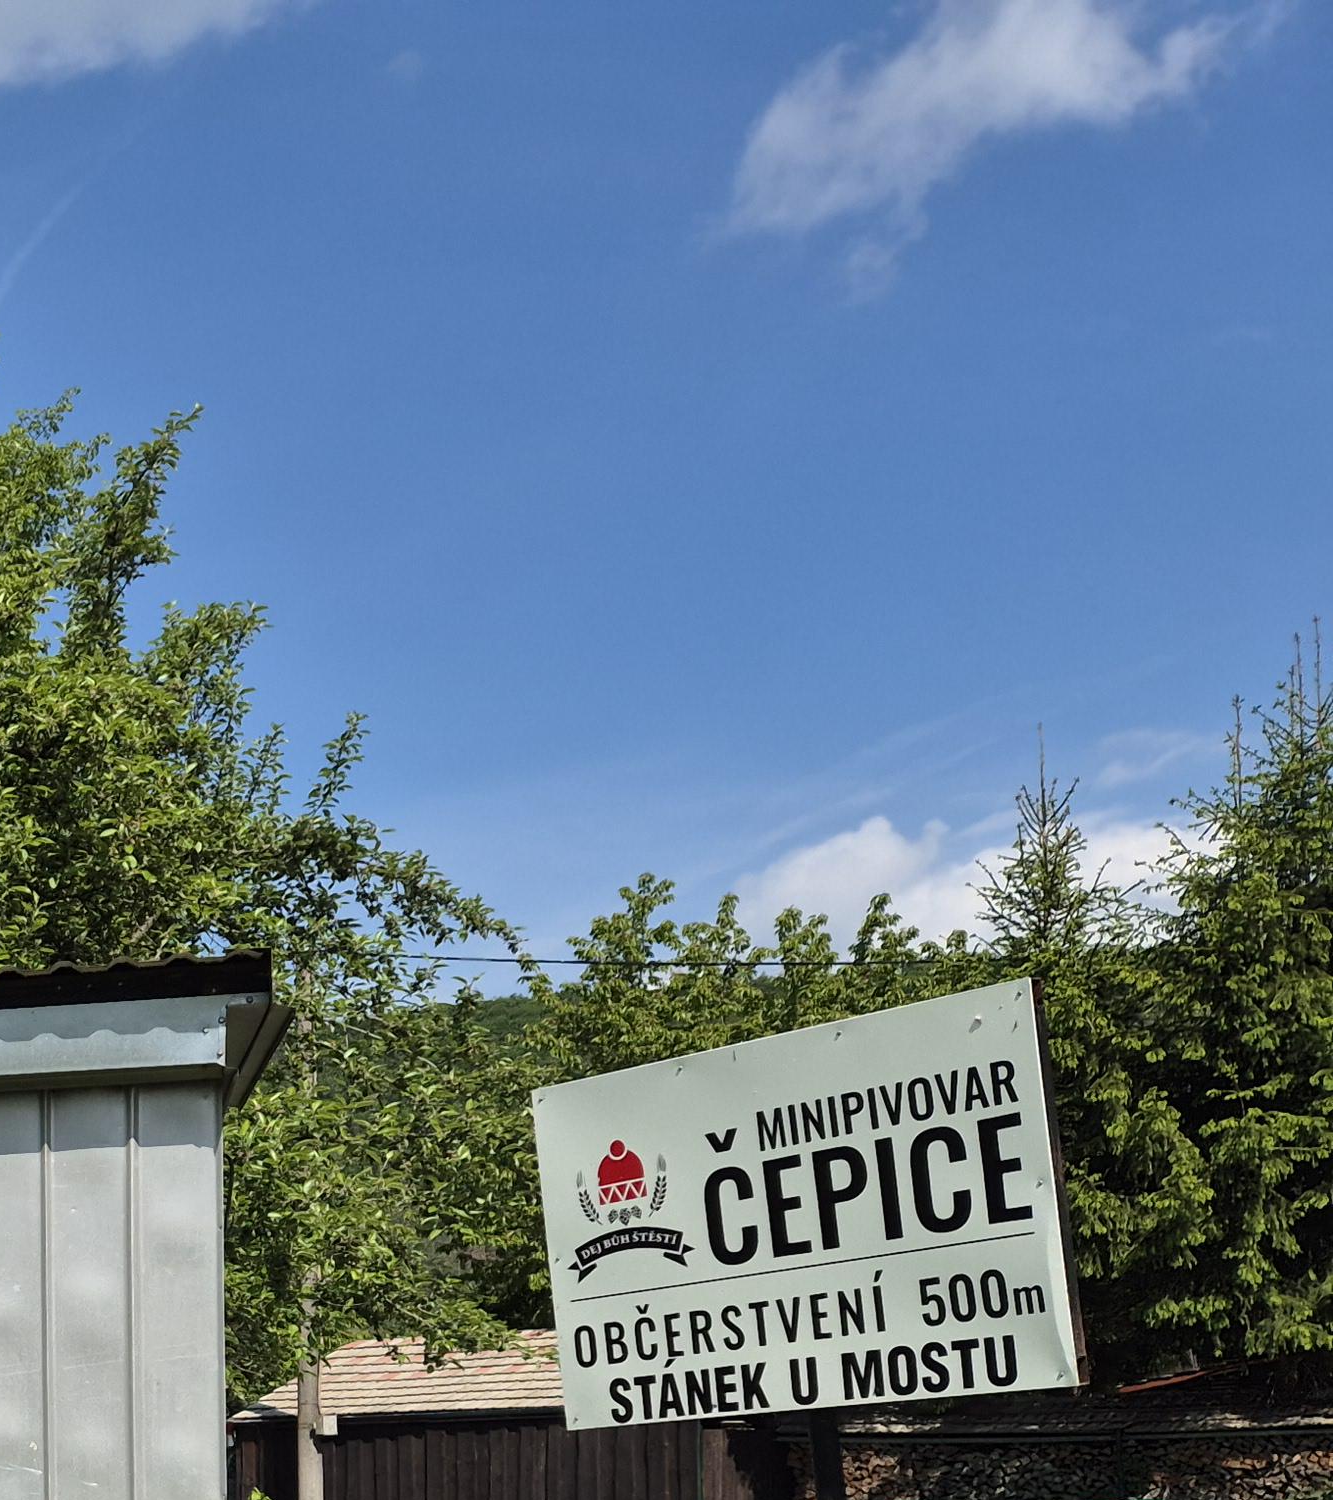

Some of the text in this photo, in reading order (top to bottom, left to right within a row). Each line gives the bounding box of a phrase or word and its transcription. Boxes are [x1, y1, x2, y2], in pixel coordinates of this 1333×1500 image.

[756, 1060, 1019, 1151] MINIPIVOVAR
[704, 1112, 1033, 1265] ČEPICE
[581, 1230, 677, 1259] DEJ BŮH ŠTĚSTÍ
[574, 1269, 1046, 1367] OBČERSTVENÍ 500m
[609, 1335, 1018, 1423] STÁNEK U MOSTU
